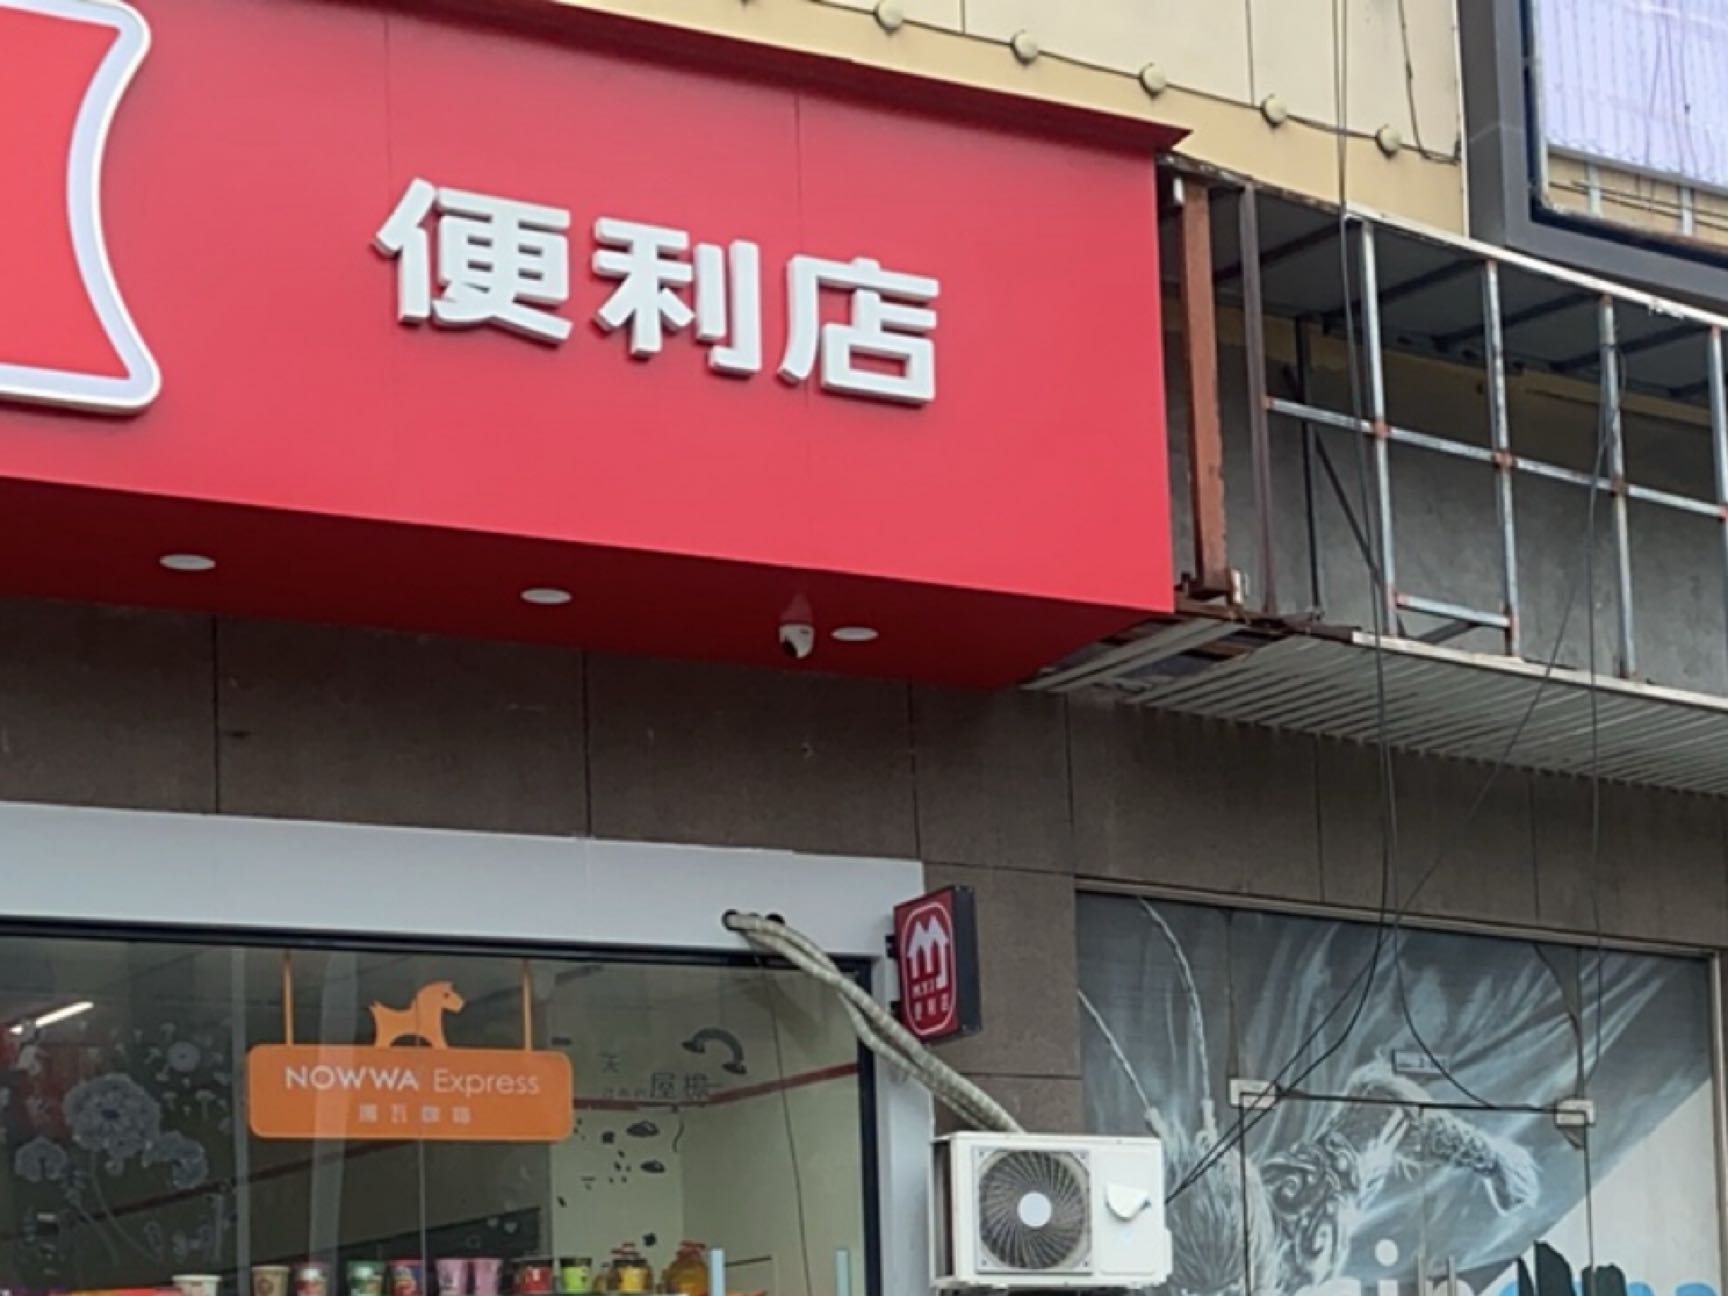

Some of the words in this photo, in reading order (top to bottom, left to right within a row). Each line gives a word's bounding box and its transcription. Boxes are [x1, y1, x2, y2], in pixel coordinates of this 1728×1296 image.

[370, 178, 940, 408] 便利店
[285, 1065, 419, 1091] NOWWA
[432, 1068, 540, 1097] Express
